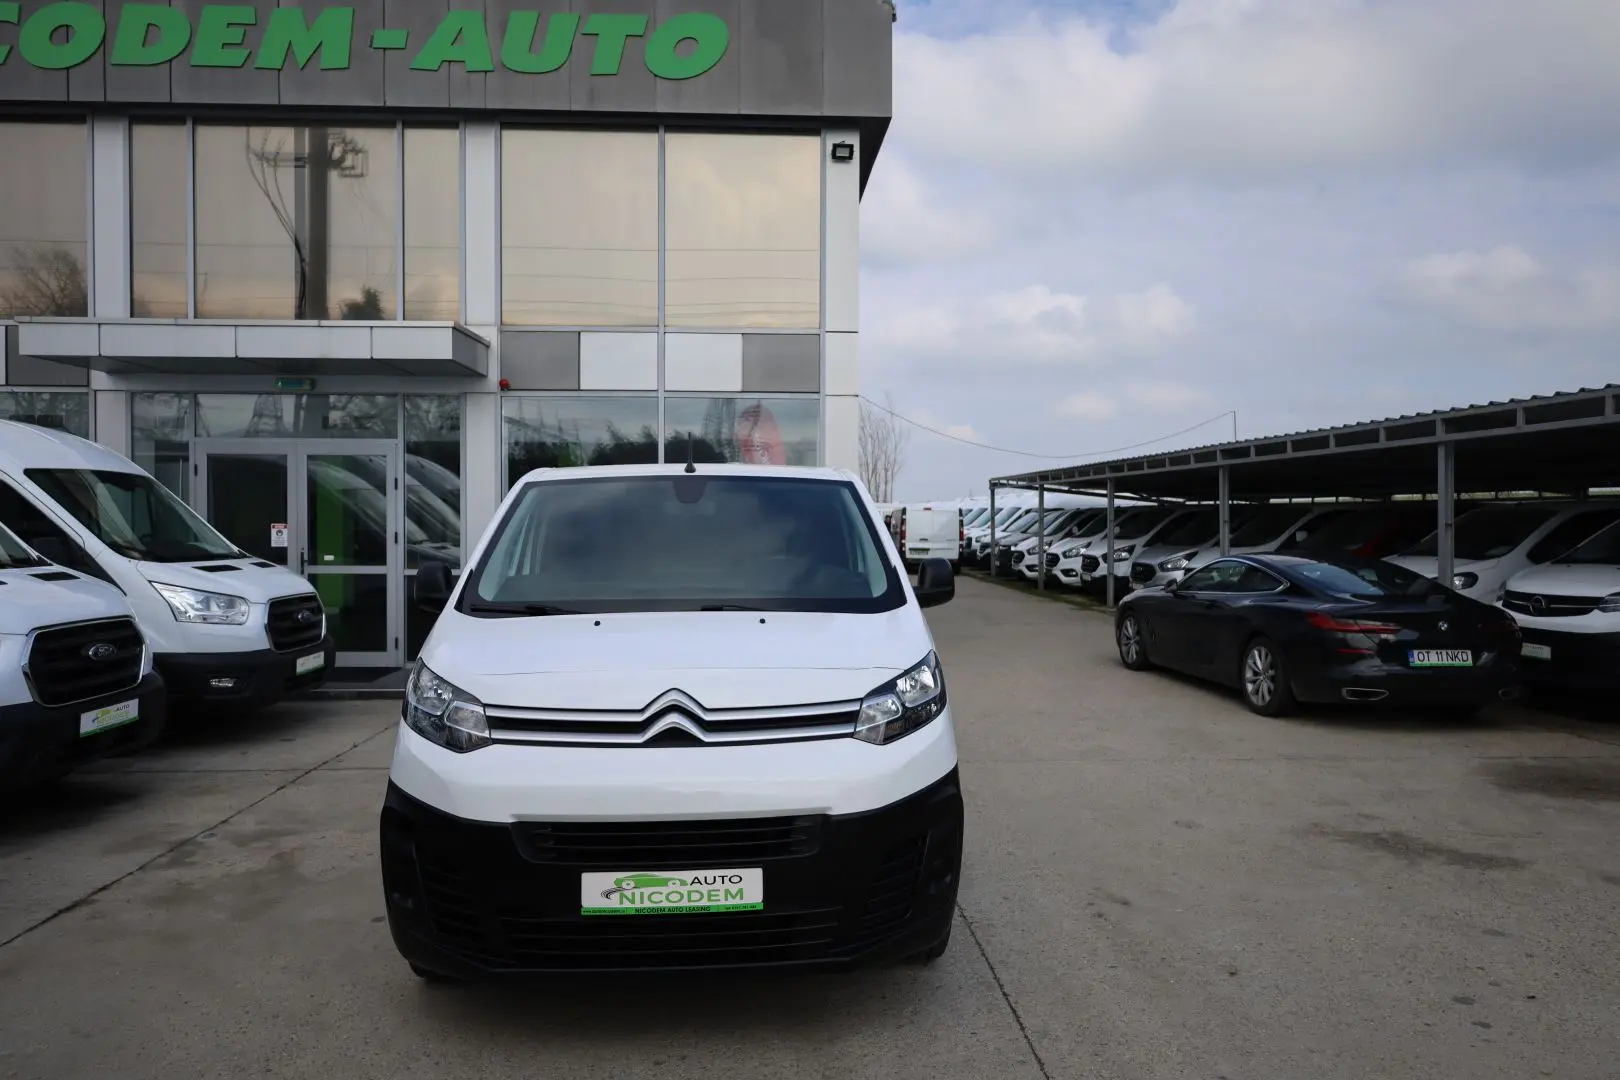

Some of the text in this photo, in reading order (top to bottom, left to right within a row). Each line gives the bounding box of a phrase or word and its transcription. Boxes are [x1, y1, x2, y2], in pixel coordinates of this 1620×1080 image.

[0, 2, 730, 80] ODEM-AUTO
[1417, 651, 1431, 662] OT
[1436, 651, 1444, 662] 11
[1446, 651, 1469, 662] NKD
[690, 875, 743, 886] AUTO
[619, 888, 744, 905] NICODEM
